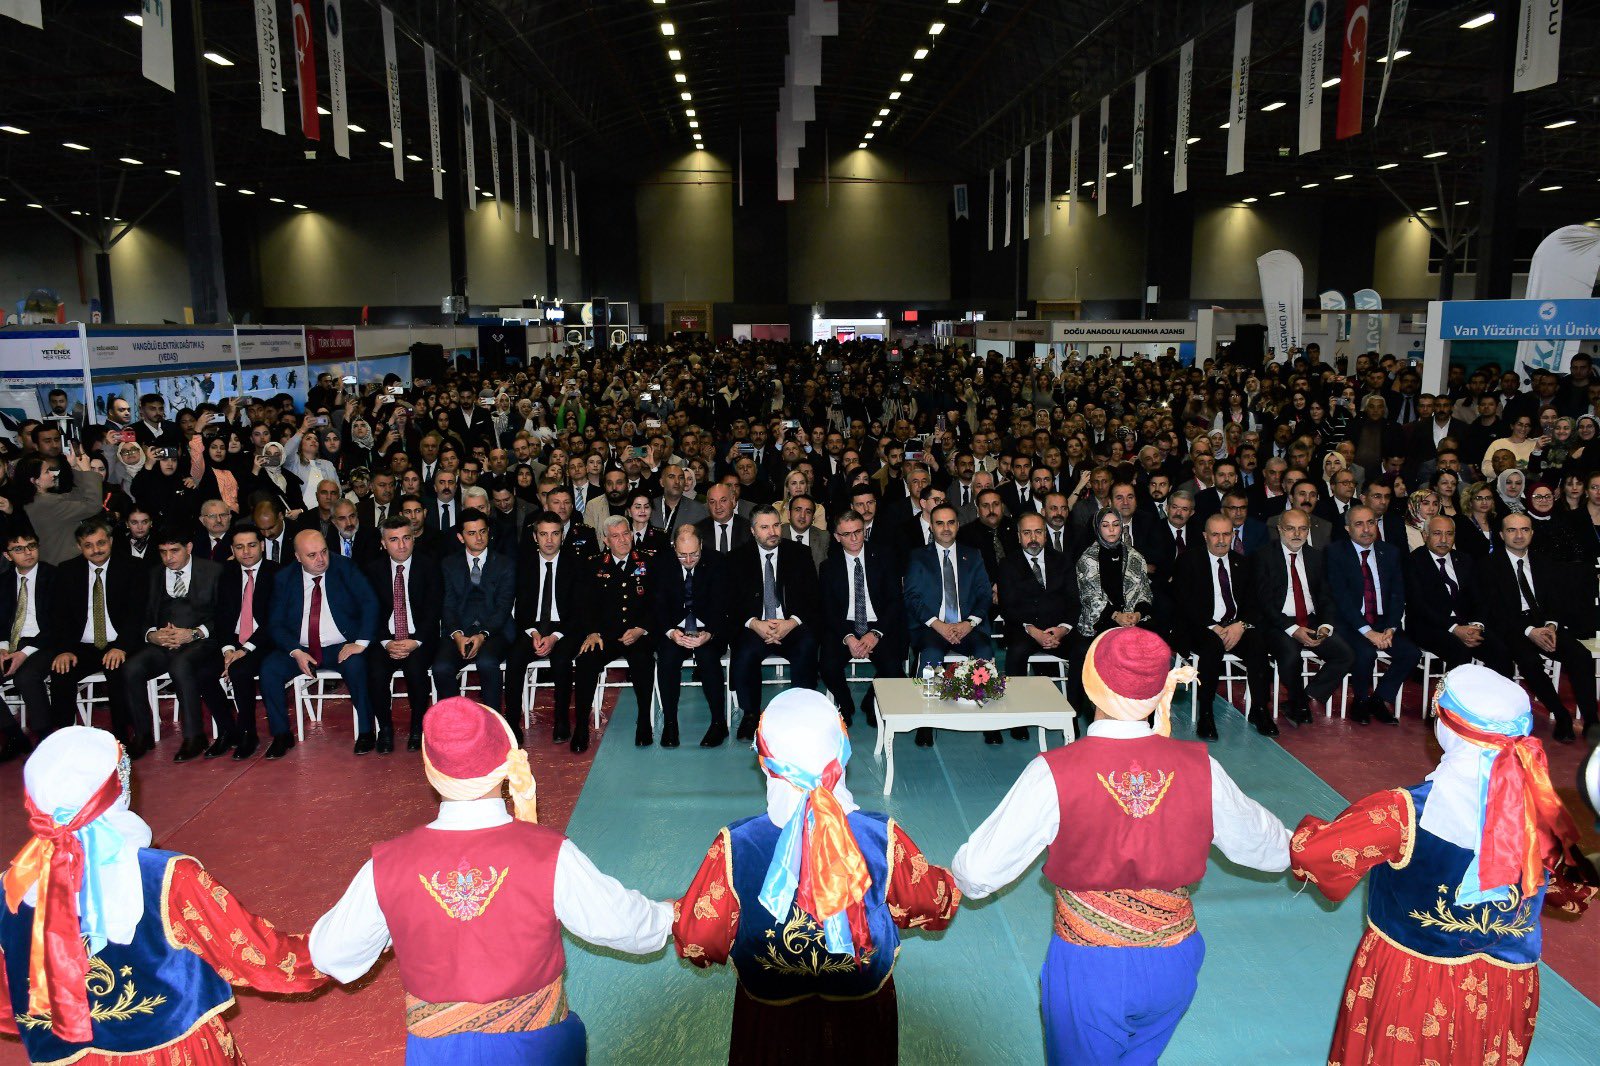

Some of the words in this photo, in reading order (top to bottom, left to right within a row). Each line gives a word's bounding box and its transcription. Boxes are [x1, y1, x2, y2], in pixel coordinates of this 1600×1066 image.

[267, 4, 278, 93] ANADOLU
[1237, 56, 1246, 124] YETENEK
[1063, 327, 1085, 335] DOĞU
[1160, 328, 1185, 336] AJANSI
[1453, 325, 1478, 336] Van
[1482, 324, 1540, 336] Yüzüncü
[1543, 324, 1562, 336] Yıl
[132, 340, 156, 351] VANGÖLÜ
